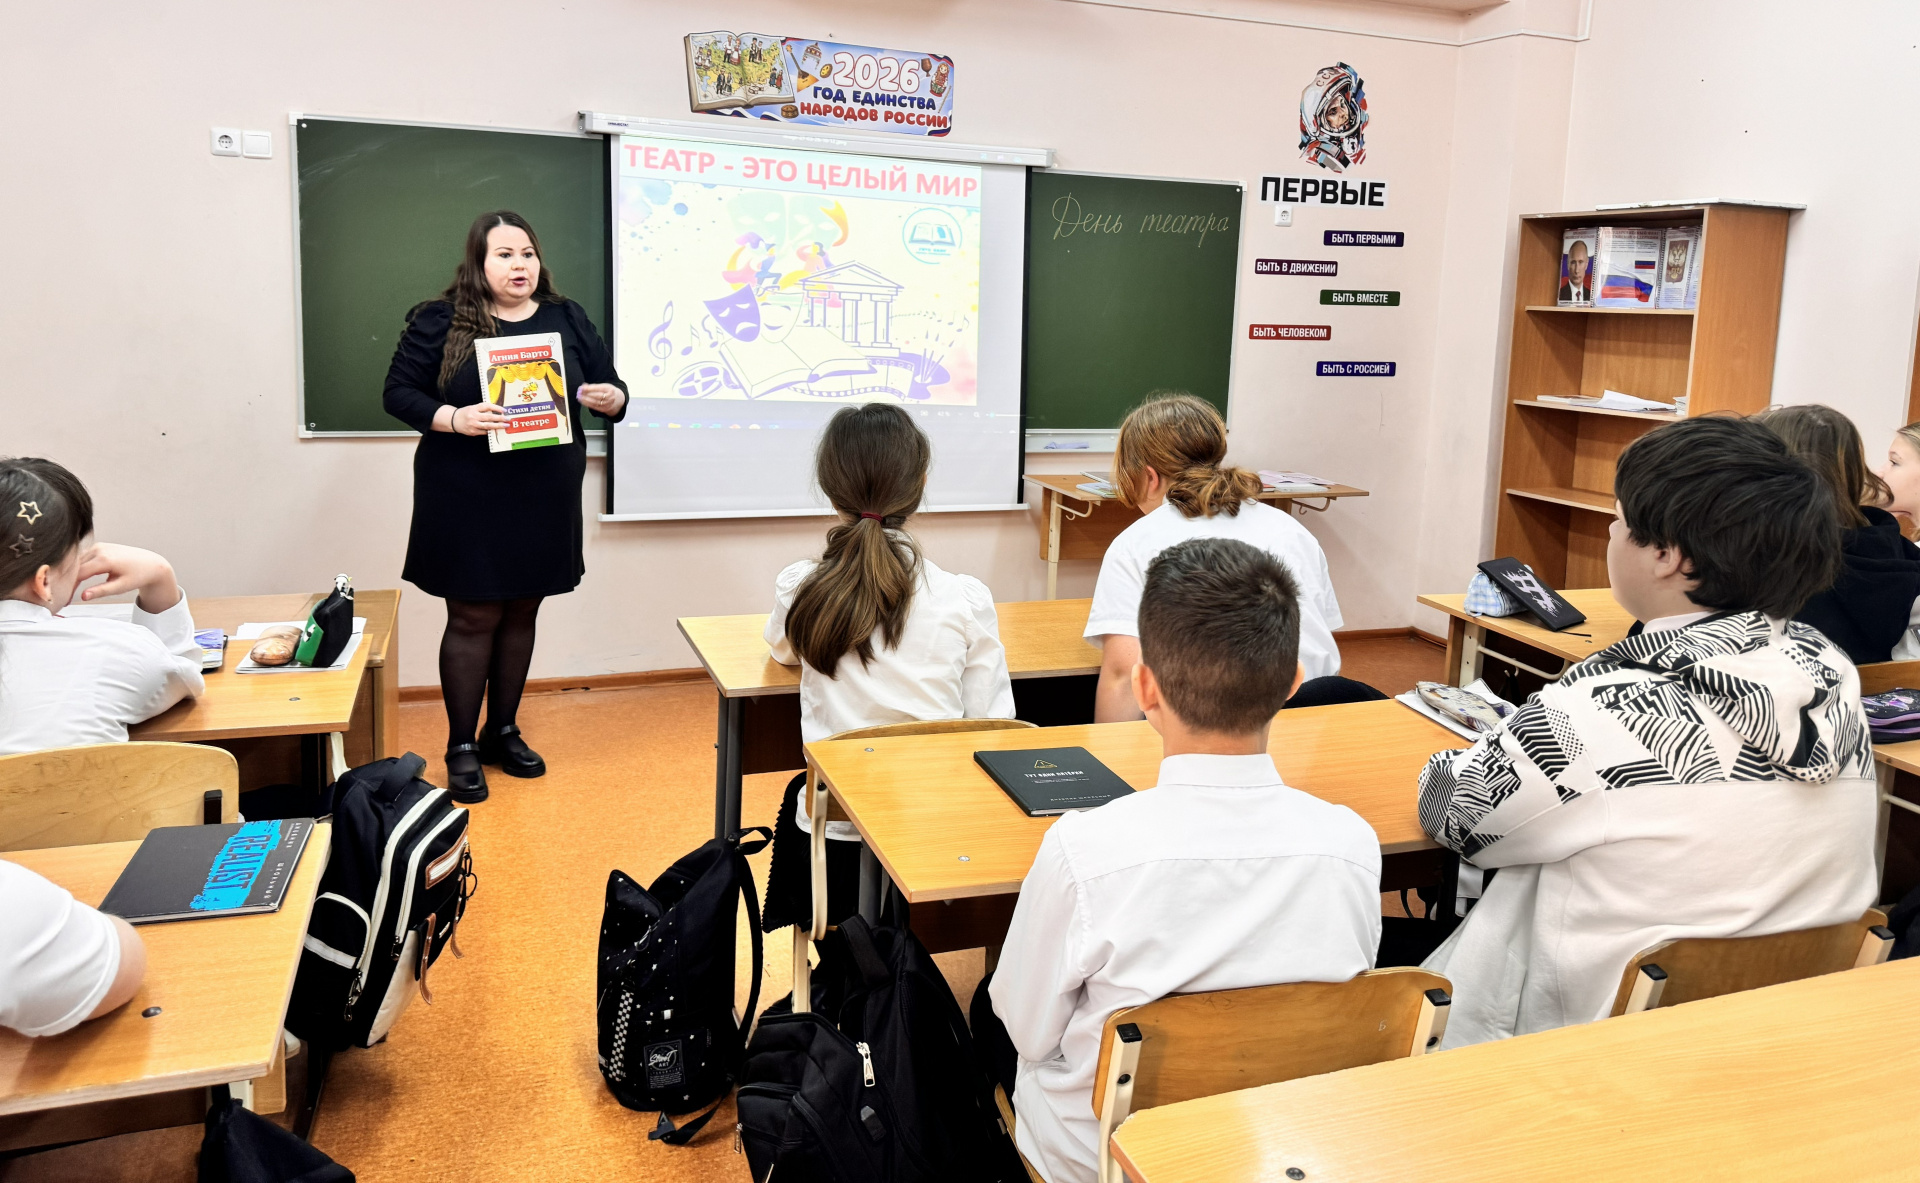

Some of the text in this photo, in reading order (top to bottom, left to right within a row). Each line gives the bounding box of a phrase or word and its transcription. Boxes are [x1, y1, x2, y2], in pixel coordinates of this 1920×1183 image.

[832, 51, 920, 94] 2026
[812, 86, 936, 110] ГОД ЕДИНСТВА
[800, 102, 948, 128] НАРОДОВ РОССИИ
[624, 144, 716, 174] ТЕАТР
[742, 157, 798, 183] ЭТО
[806, 164, 907, 193] ЦЕЛЫЙ
[916, 172, 978, 198] МИР
[1260, 176, 1386, 206] ПЕРВЫЕ
[1052, 192, 1230, 248] День театра
[1332, 234, 1396, 244] БЫТЬ ПЕРВЫМИ
[1256, 262, 1336, 274] БЫТЬ В ДВИЖЕНИИ
[1332, 293, 1388, 303] БЫТЬ ВМЕСТЕ
[1253, 327, 1327, 338] БЫТЬ ЧЕЛОВЕКОМ
[491, 350, 549, 362] Агния Барто
[1322, 363, 1390, 374] БЫТЬ С РОССИЕЙ
[508, 404, 551, 414] Стихи детям
[520, 418, 550, 427] театре
[205, 834, 272, 890] REALIST
